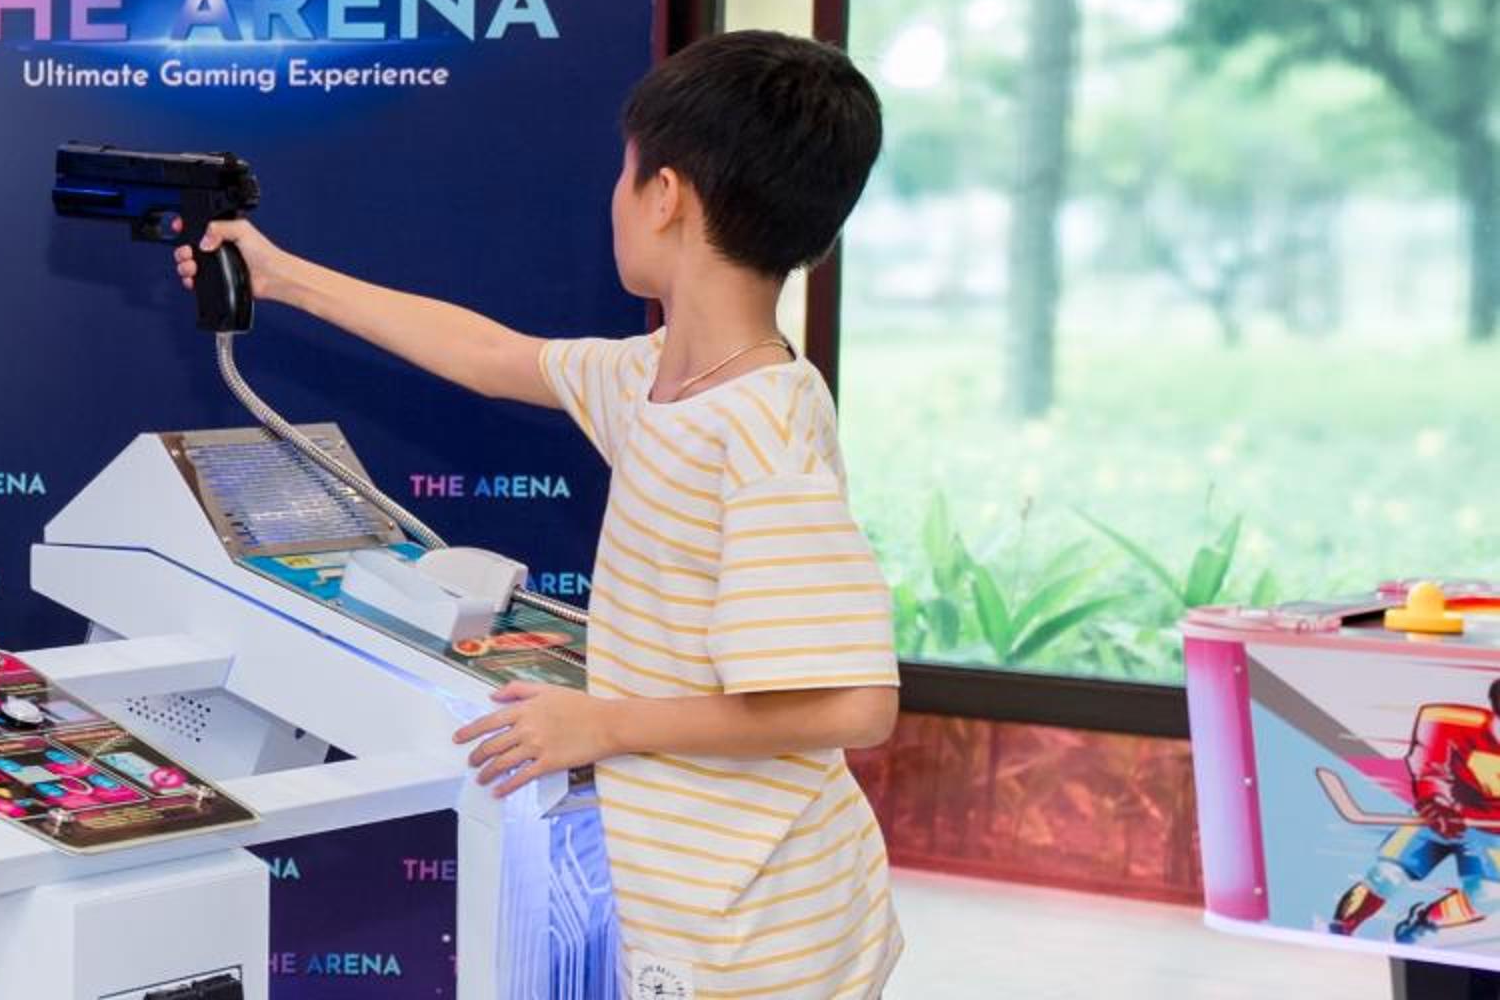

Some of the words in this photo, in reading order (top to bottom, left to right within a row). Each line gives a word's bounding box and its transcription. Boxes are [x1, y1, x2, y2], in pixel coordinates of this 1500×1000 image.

[22, 59, 150, 88] Ultimate
[160, 59, 277, 93] Gaming
[288, 59, 450, 93] Experience
[410, 474, 465, 498] THE
[474, 475, 572, 499] ARENA
[526, 571, 592, 595] AREN
[404, 858, 457, 882] THE
[306, 952, 402, 976] ARENA
